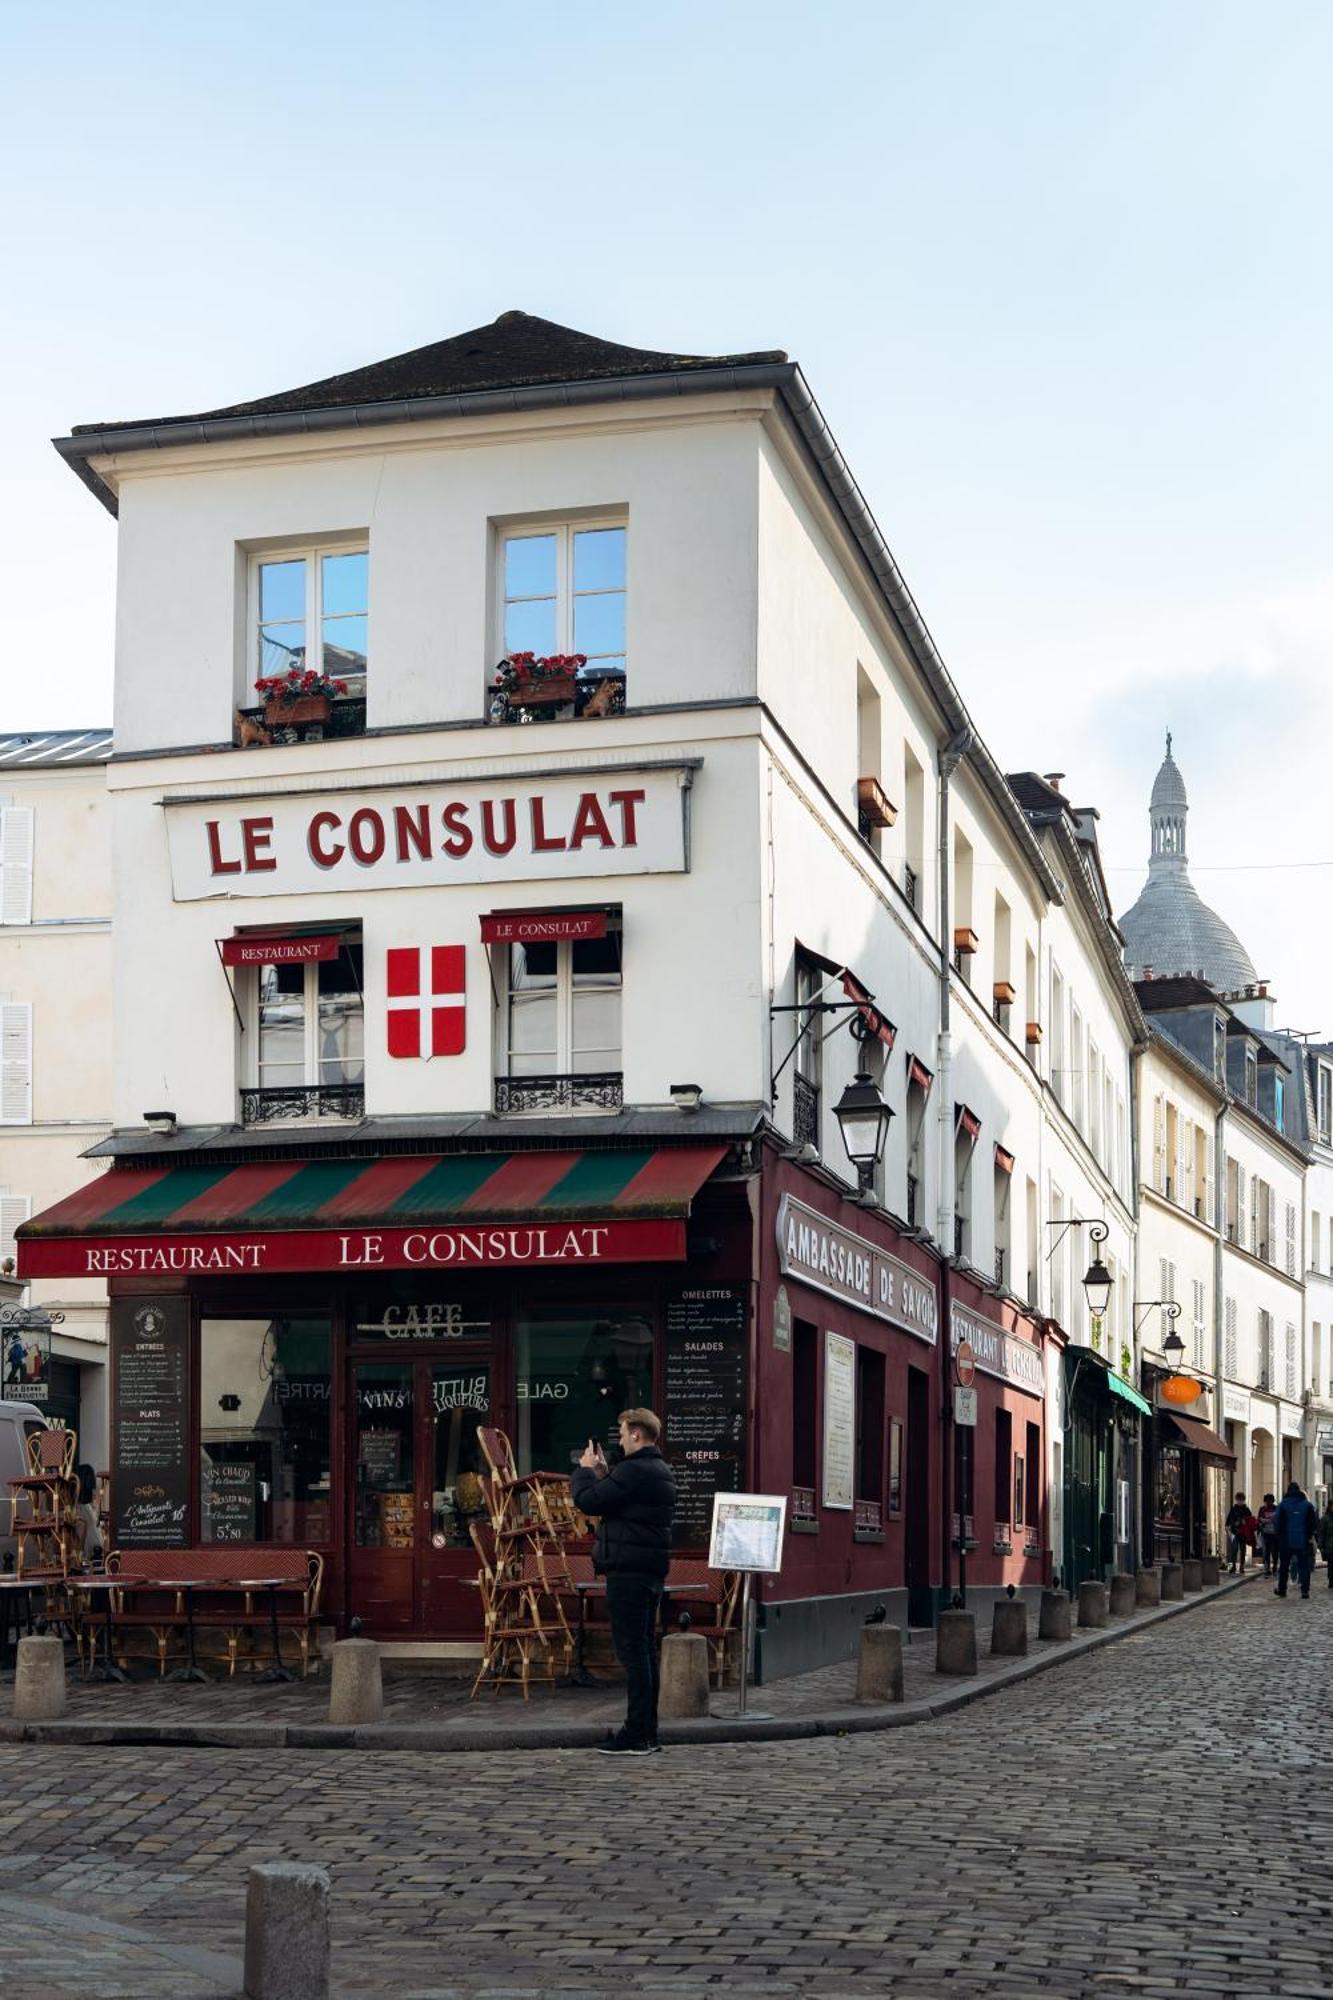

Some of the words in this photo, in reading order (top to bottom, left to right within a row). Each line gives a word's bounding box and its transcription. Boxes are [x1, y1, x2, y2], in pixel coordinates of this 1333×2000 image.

[205, 816, 277, 876] LE
[307, 789, 646, 870] CONSULAT
[496, 924, 513, 937] LE
[518, 921, 591, 936] CONSULAT
[241, 944, 320, 960] RESTAURANT
[86, 1244, 266, 1271] RESTAURANT
[339, 1236, 385, 1264] LE
[403, 1228, 608, 1262] CONSULAT
[787, 1217, 870, 1296] AMBASSADE
[880, 1267, 894, 1307] DE
[682, 1290, 732, 1300] OMELETTES
[684, 1342, 724, 1352] SALADES
[363, 1391, 405, 1409] VINS
[433, 1393, 489, 1412] LIQUEURS
[139, 1410, 161, 1418] PLATS
[685, 1450, 720, 1460] CRÊPES
